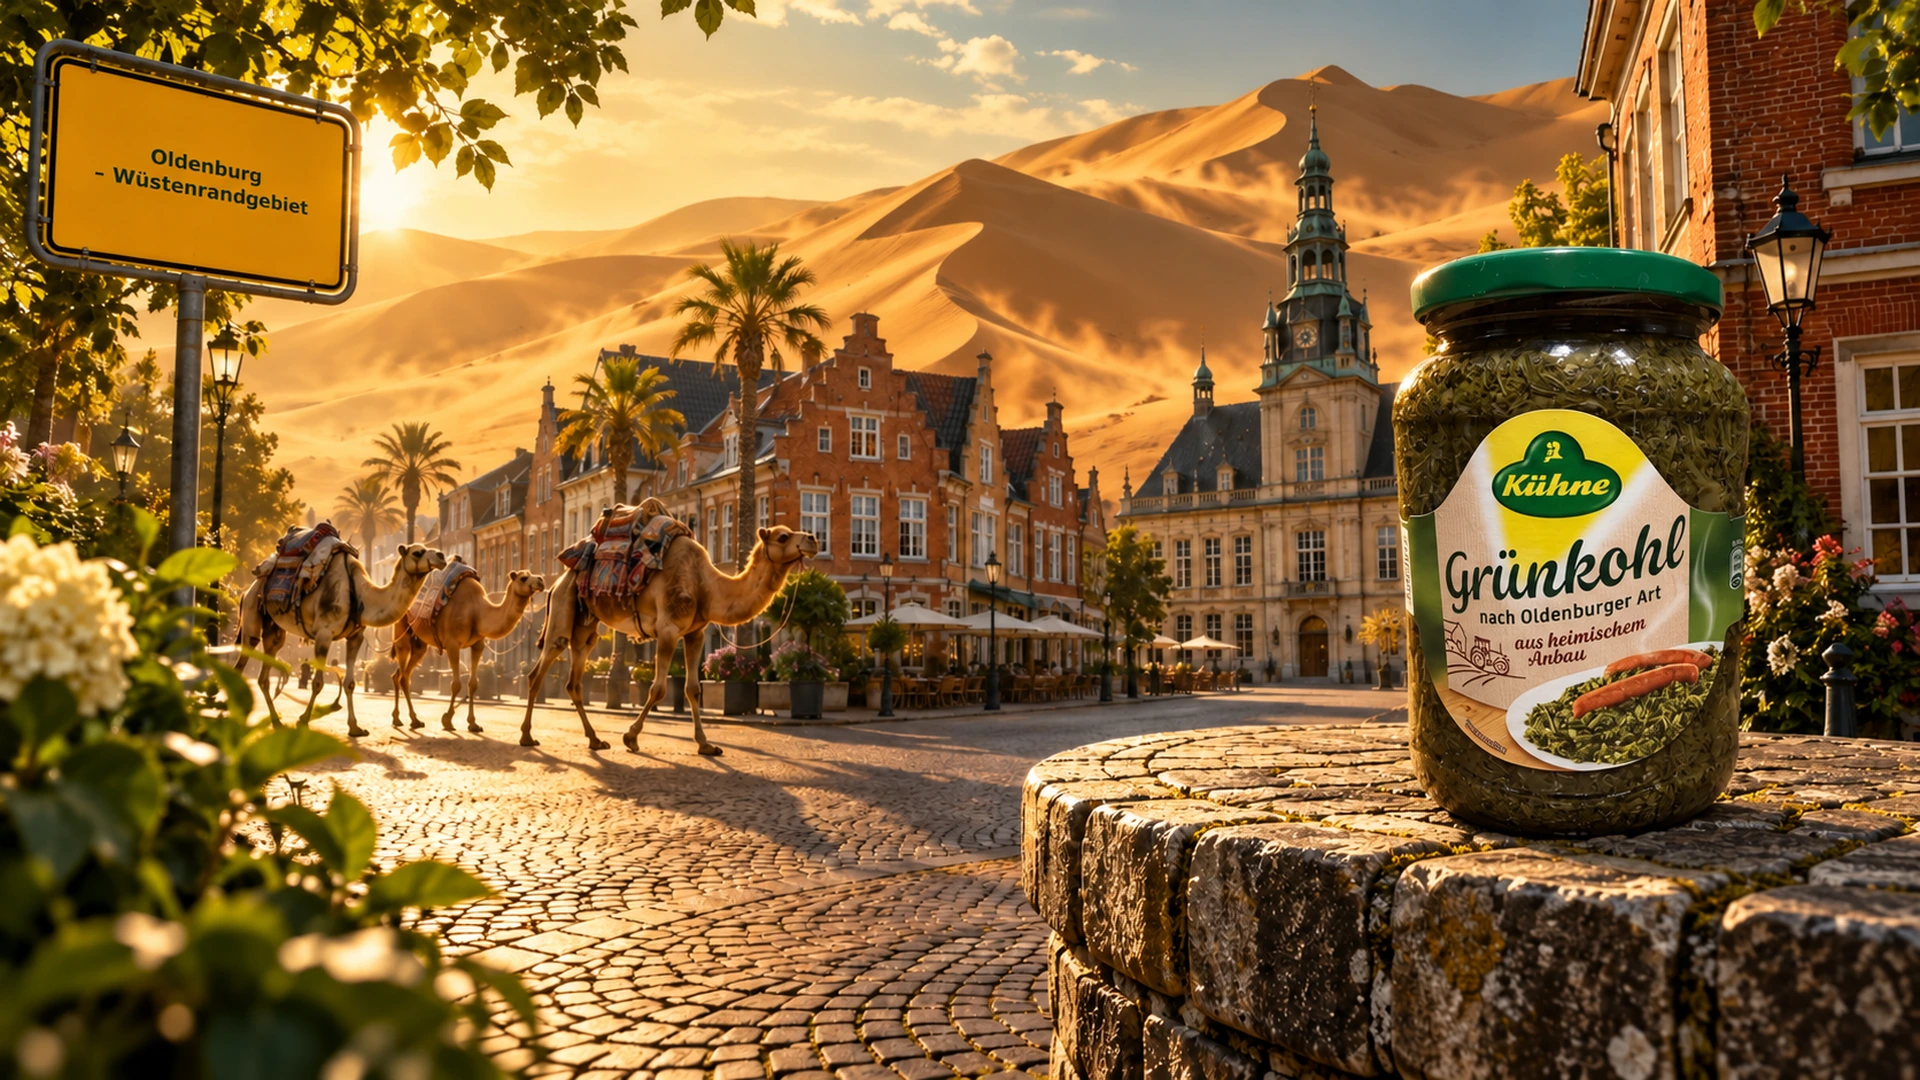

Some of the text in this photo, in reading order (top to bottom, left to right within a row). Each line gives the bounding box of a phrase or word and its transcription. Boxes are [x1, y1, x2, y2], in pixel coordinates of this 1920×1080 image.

[151, 148, 262, 187] Oldenburg
[113, 167, 308, 215] Wüstenrandgebiet
[1502, 473, 1611, 497] Kühne
[1446, 514, 1686, 613] Grünkohl
[1479, 585, 1662, 625] nach Oldenburger Art
[1514, 618, 1647, 650] aus heimischem
[1528, 648, 1587, 667] Anbau
